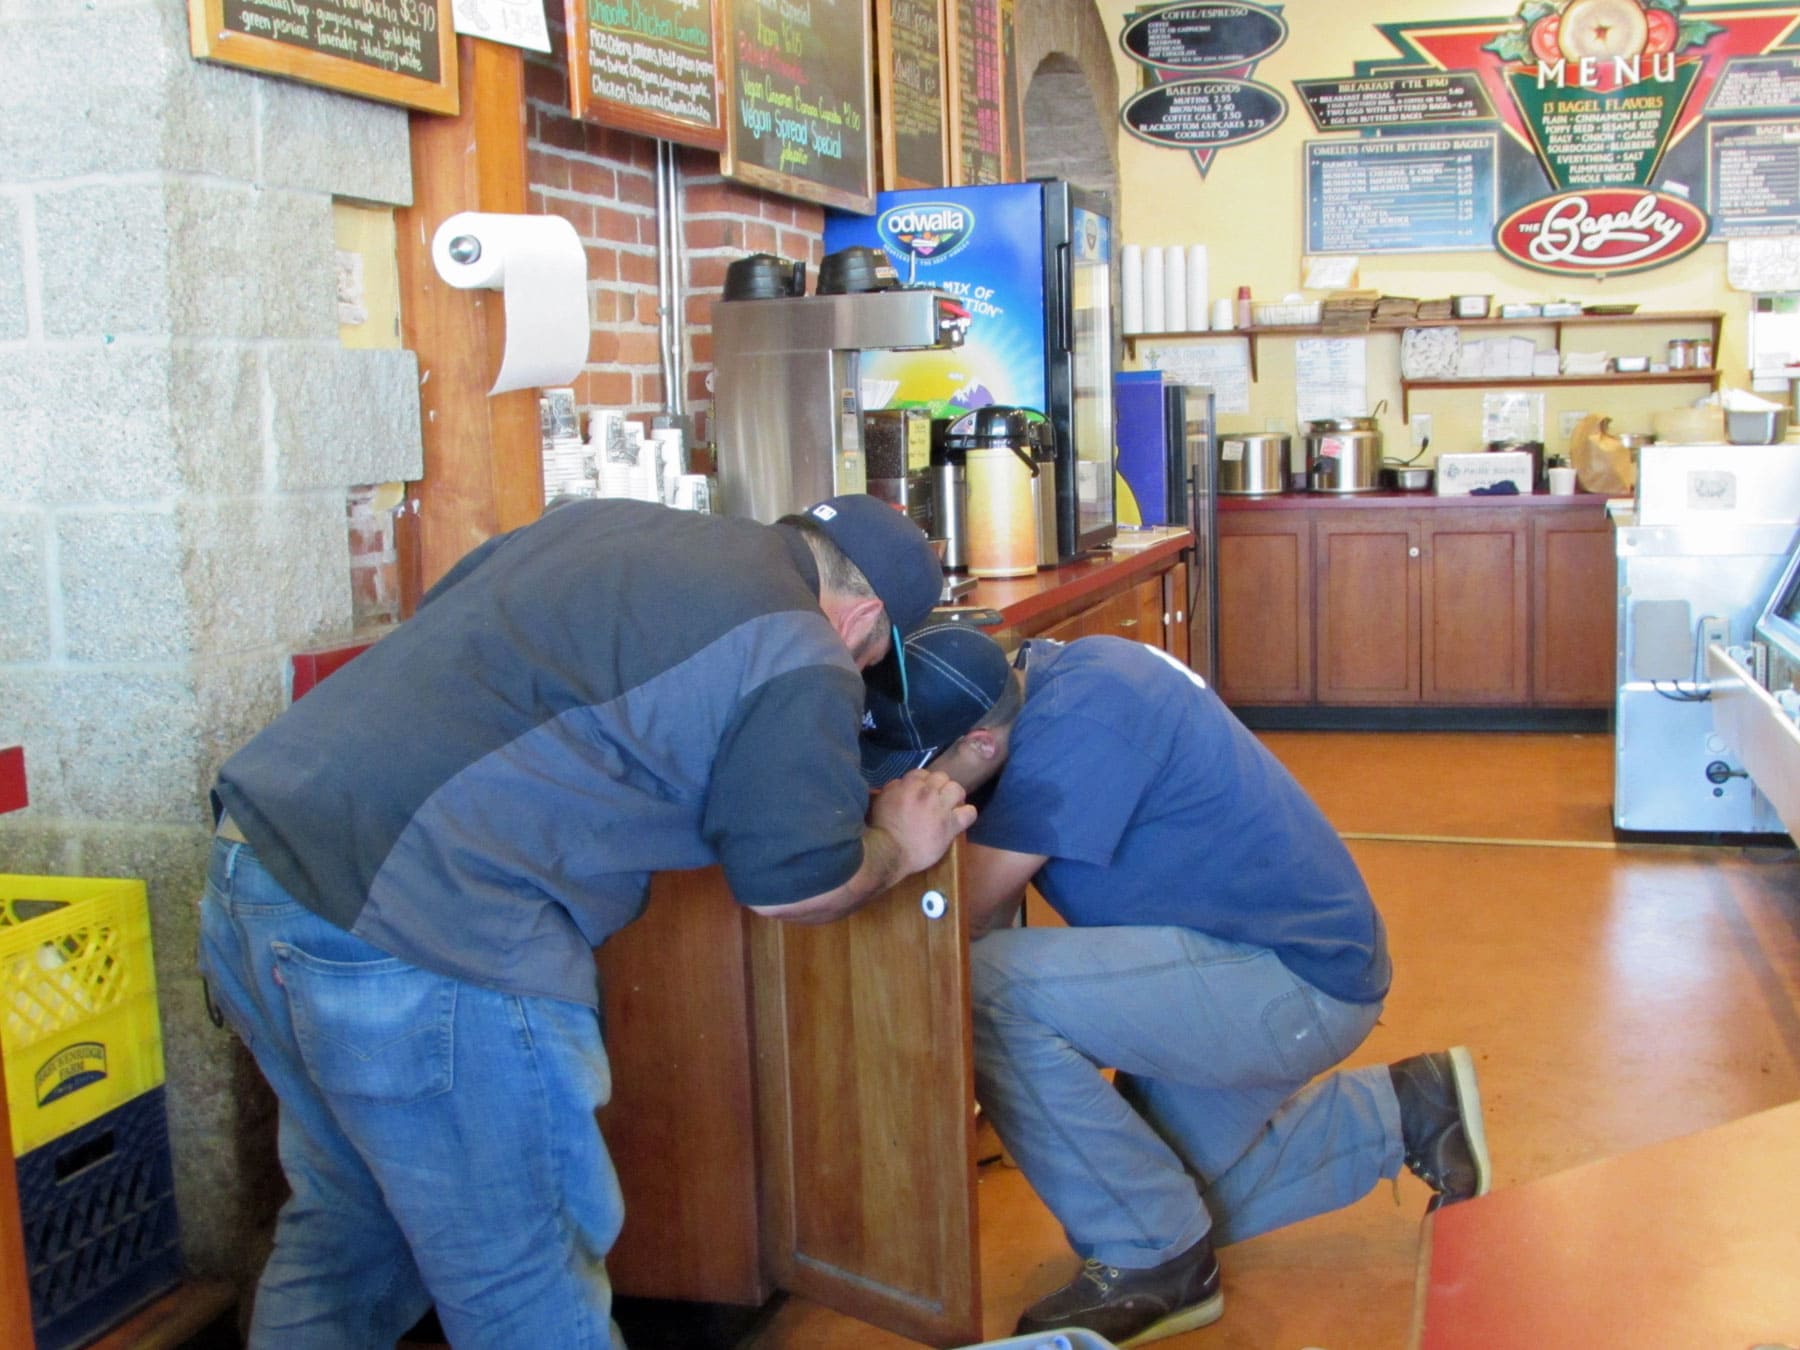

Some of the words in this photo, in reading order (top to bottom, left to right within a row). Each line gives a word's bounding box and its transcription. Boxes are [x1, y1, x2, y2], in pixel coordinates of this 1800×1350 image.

[1162, 8, 1248, 20] COFFEE/ESPRESSO
[1537, 52, 1675, 89] MENU
[1166, 86, 1200, 96] BAKED
[1204, 84, 1241, 95] GOODS
[1339, 81, 1395, 93] BREAKFAST
[1173, 96, 1209, 104] MUFFINS
[1320, 94, 1360, 103] BREAKFAST
[1363, 92, 1391, 100] SPECIAL
[1169, 105, 1212, 114] BROWNIES
[1327, 109, 1344, 117] TWO
[1346, 108, 1364, 116] EGGS
[1366, 106, 1386, 114] WITH
[1388, 104, 1427, 113] BUTTERED
[1429, 102, 1451, 111] BAGEL
[1544, 102, 1555, 113] 13
[1558, 100, 1600, 112] BAGEL
[1605, 96, 1663, 110] FLAVORS
[1163, 114, 1193, 122] COFFEE
[1194, 113, 1217, 121] CAKE
[1331, 117, 1345, 125] EGG
[1360, 114, 1399, 123] BUTTERED
[1400, 113, 1422, 121] BAGEL
[1542, 115, 1567, 124] PLAIN
[1575, 112, 1631, 122] CINNAMON
[1633, 110, 1661, 119] RAISIN
[741, 98, 771, 139] Vegan
[775, 108, 808, 148] Spread
[811, 119, 842, 159] Special
[1202, 121, 1245, 129] CUPCAKES
[1545, 125, 1571, 134] POPPY
[1573, 124, 1594, 133] SEED
[1602, 122, 1637, 132] SESAME
[1639, 120, 1658, 129] SEED
[1175, 131, 1211, 139] COOKIES
[1549, 134, 1572, 143] BIALY
[1582, 132, 1615, 142] ONION
[1623, 130, 1654, 140] GARLIC
[1313, 144, 1358, 156] OMELETS
[1362, 143, 1394, 153] (WITH
[1397, 141, 1451, 152] BUTTERED
[1453, 139, 1489, 149] BAGEL)
[1548, 142, 1605, 153] SOURDOUGH
[1610, 140, 1656, 151] BLUEBERRY
[1557, 153, 1614, 164] EVERYTHING
[1623, 151, 1644, 161] SALT
[1569, 163, 1635, 174] PUMPERNICKEL
[1569, 174, 1600, 184] WHOLE
[1604, 173, 1635, 183] WHEAT
[888, 208, 964, 233] odwalla
[1519, 224, 1540, 232] THE
[1529, 194, 1684, 265] Bagelry
[943, 281, 971, 295] MIX
[974, 286, 995, 300] OF
